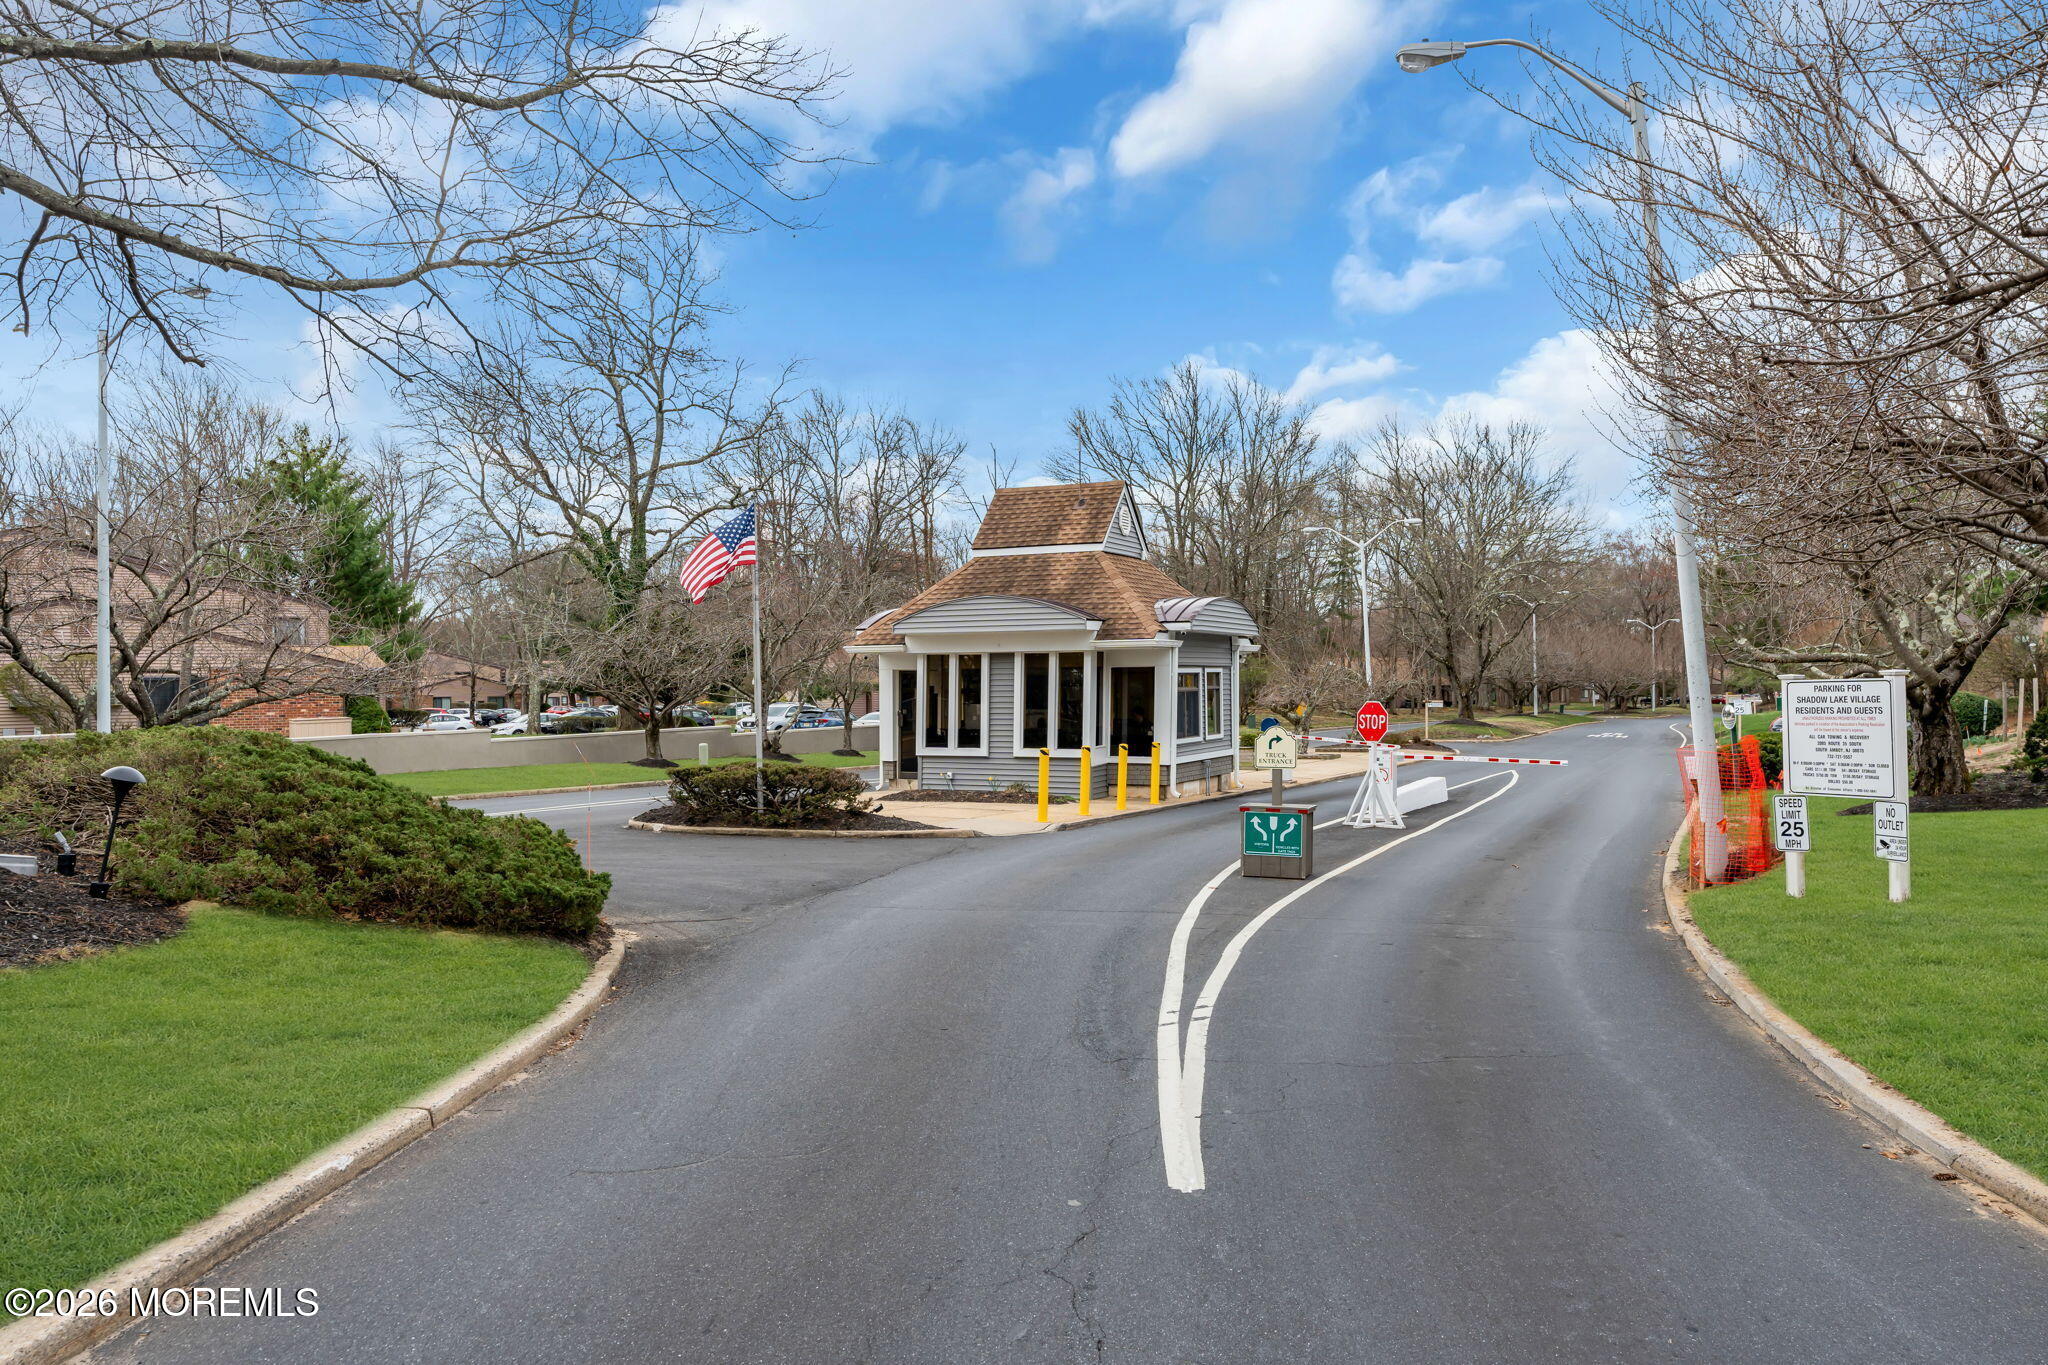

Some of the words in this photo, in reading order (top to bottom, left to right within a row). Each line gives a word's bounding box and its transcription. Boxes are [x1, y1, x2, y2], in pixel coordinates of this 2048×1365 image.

[1814, 684, 1845, 692] PARKING
[1796, 706, 1834, 714] RESIDENTS
[1854, 706, 1883, 714] GUESTS
[1360, 714, 1386, 730] STOP
[1778, 798, 1802, 808] SPEED
[1782, 810, 1800, 819] LIMIT
[1886, 808, 1896, 818] NO
[1780, 821, 1804, 837] 25
[1878, 819, 1904, 830] OUTLET
[1785, 839, 1802, 848] MPH
